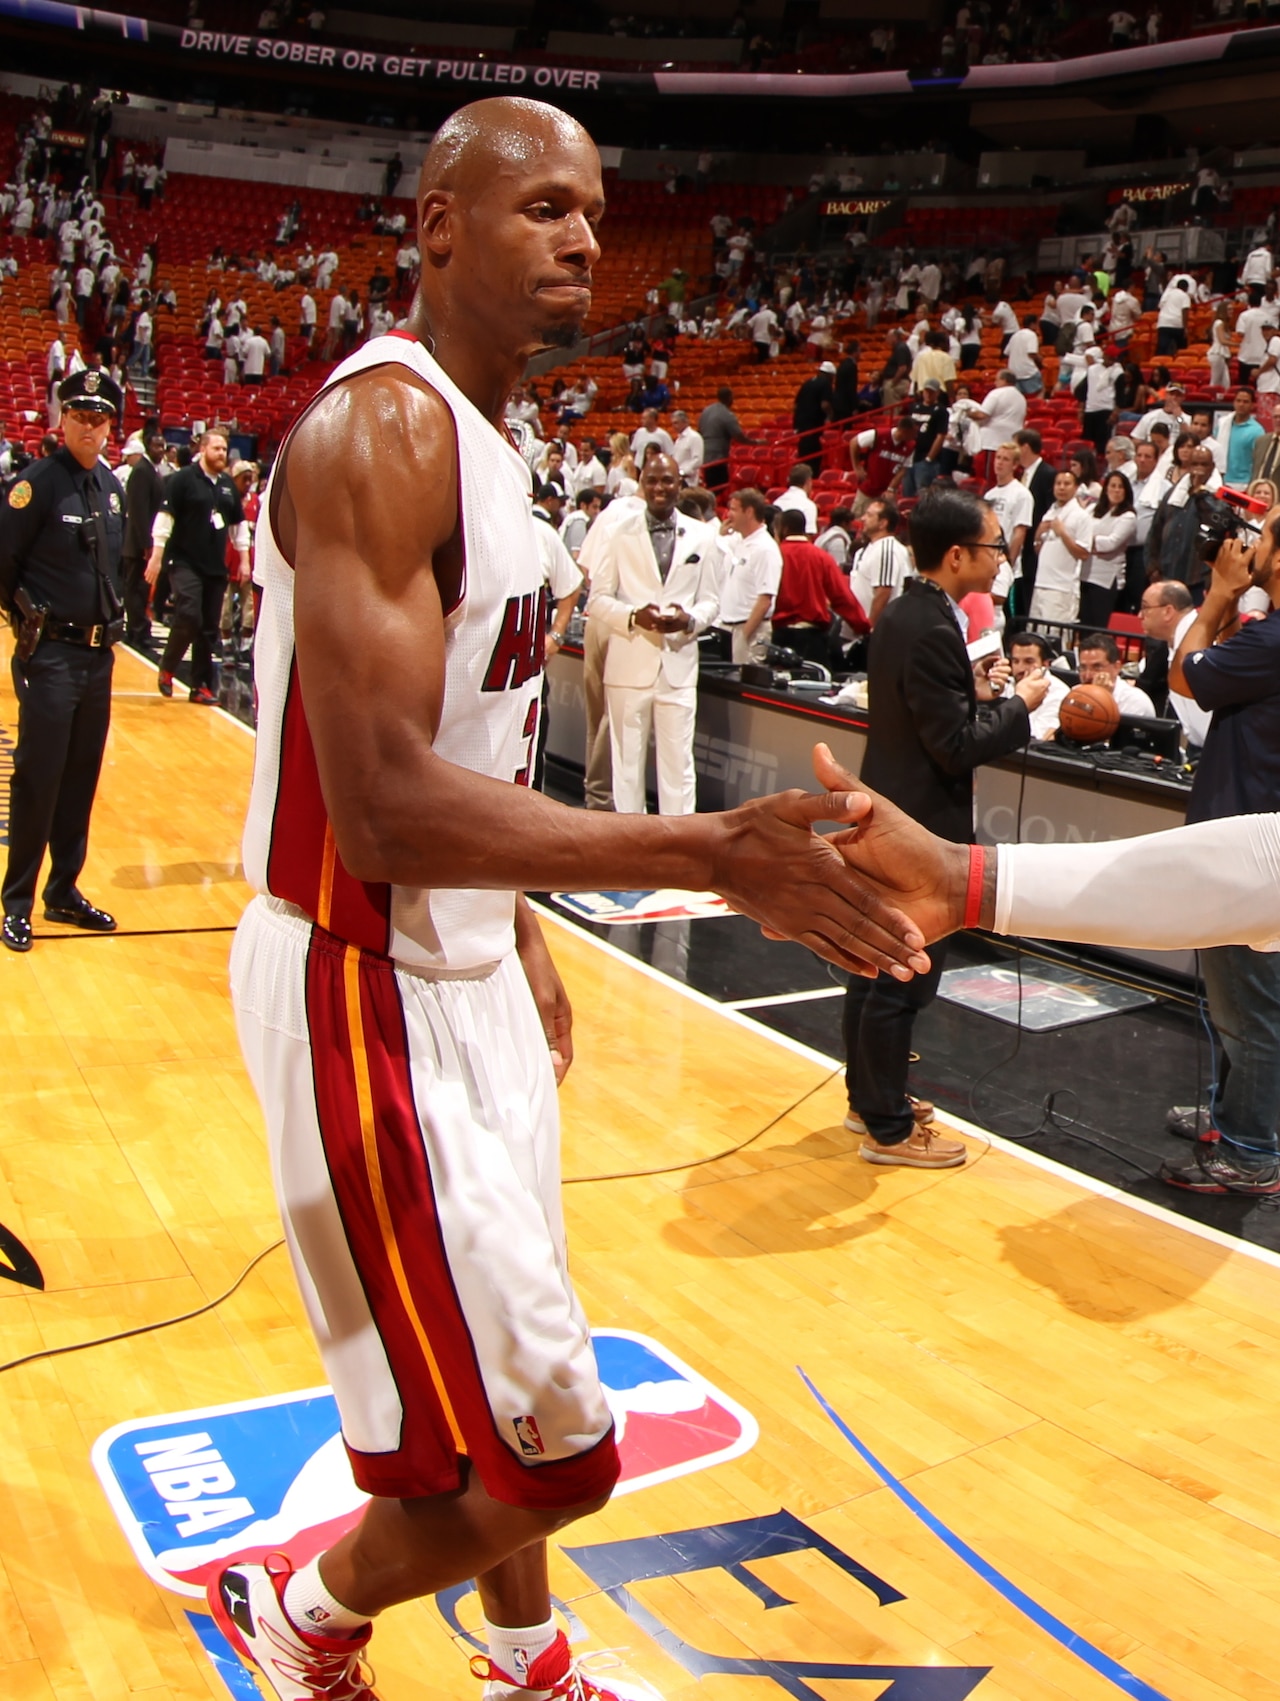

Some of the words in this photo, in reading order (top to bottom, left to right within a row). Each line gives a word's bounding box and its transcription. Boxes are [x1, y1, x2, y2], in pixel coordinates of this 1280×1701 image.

[180, 30, 251, 55] DRIVE
[256, 39, 336, 66] SOBER
[342, 51, 377, 72] OR
[383, 56, 431, 77] GET
[436, 60, 527, 84] PULLED
[534, 68, 601, 90] OVER
[133, 1431, 256, 1539] NBA
